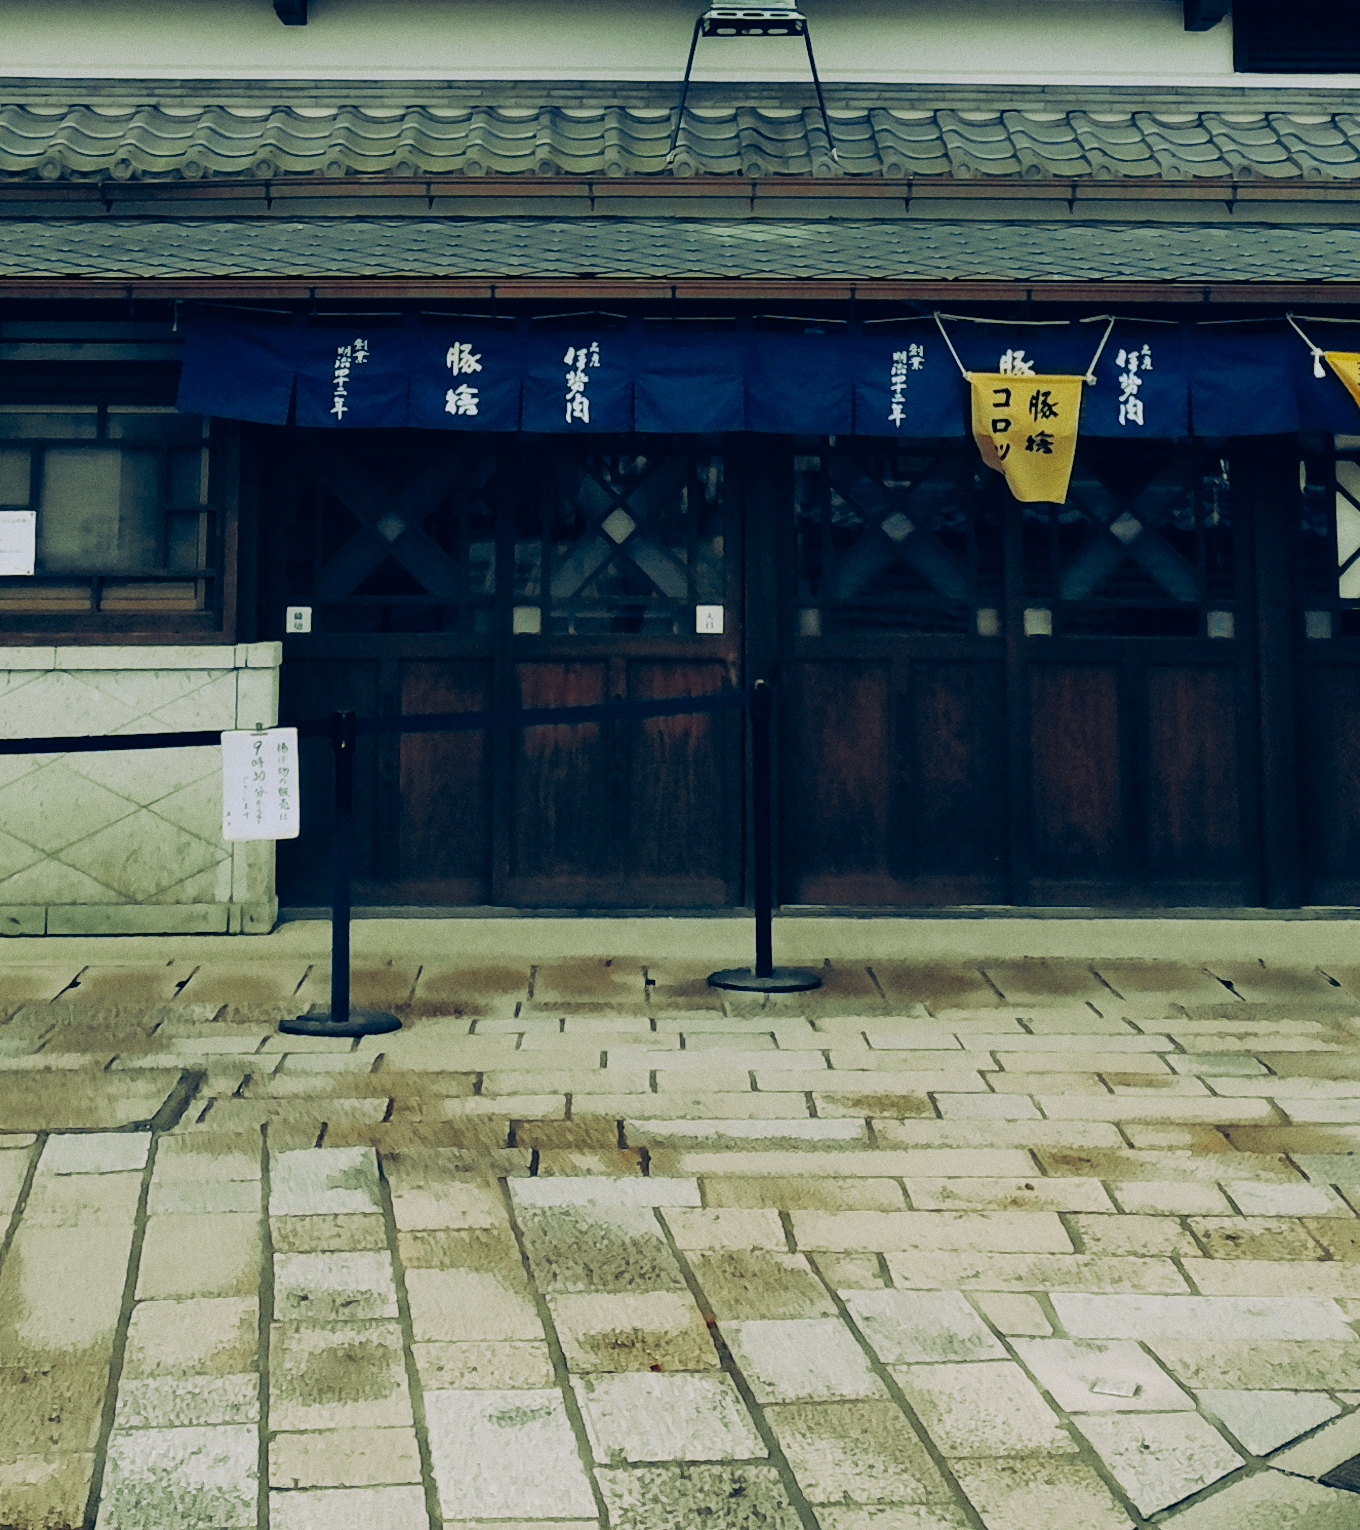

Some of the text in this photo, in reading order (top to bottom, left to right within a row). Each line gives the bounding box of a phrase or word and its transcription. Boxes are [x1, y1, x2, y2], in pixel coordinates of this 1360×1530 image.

[330, 346, 351, 421] 明治四十二年
[445, 342, 482, 416] 豚捨
[564, 347, 589, 424] 伊勢肉
[888, 351, 907, 428] 明治四十二年
[1115, 349, 1144, 426] 伊勢肉
[1025, 389, 1059, 455] 豚捨
